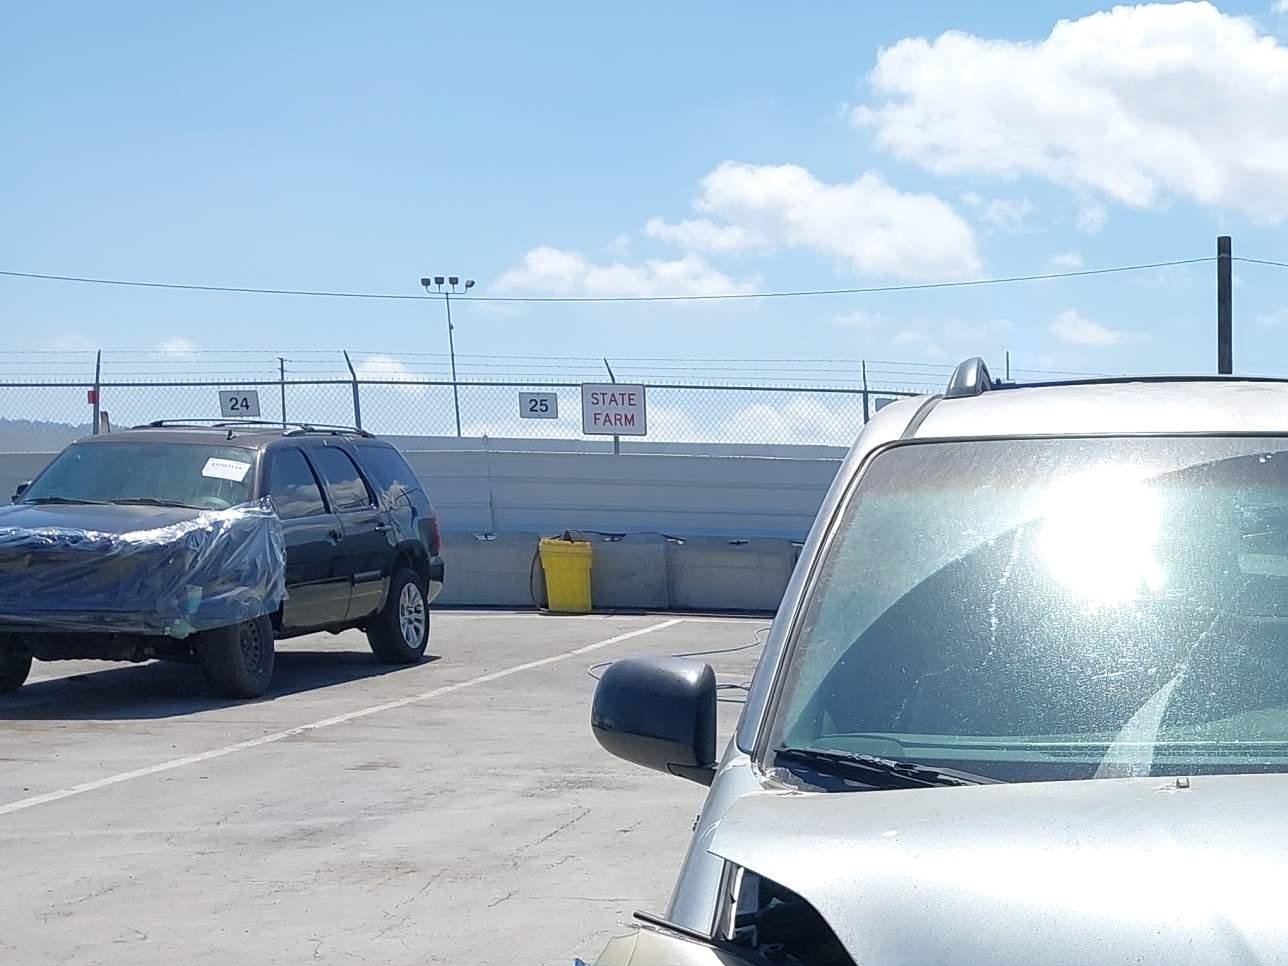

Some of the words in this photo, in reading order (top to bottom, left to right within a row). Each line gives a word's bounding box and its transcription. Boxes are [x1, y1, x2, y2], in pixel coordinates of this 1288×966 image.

[229, 397, 250, 411] 24
[528, 398, 549, 413] 25
[591, 392, 637, 407] STATE
[593, 412, 636, 427] FARM
